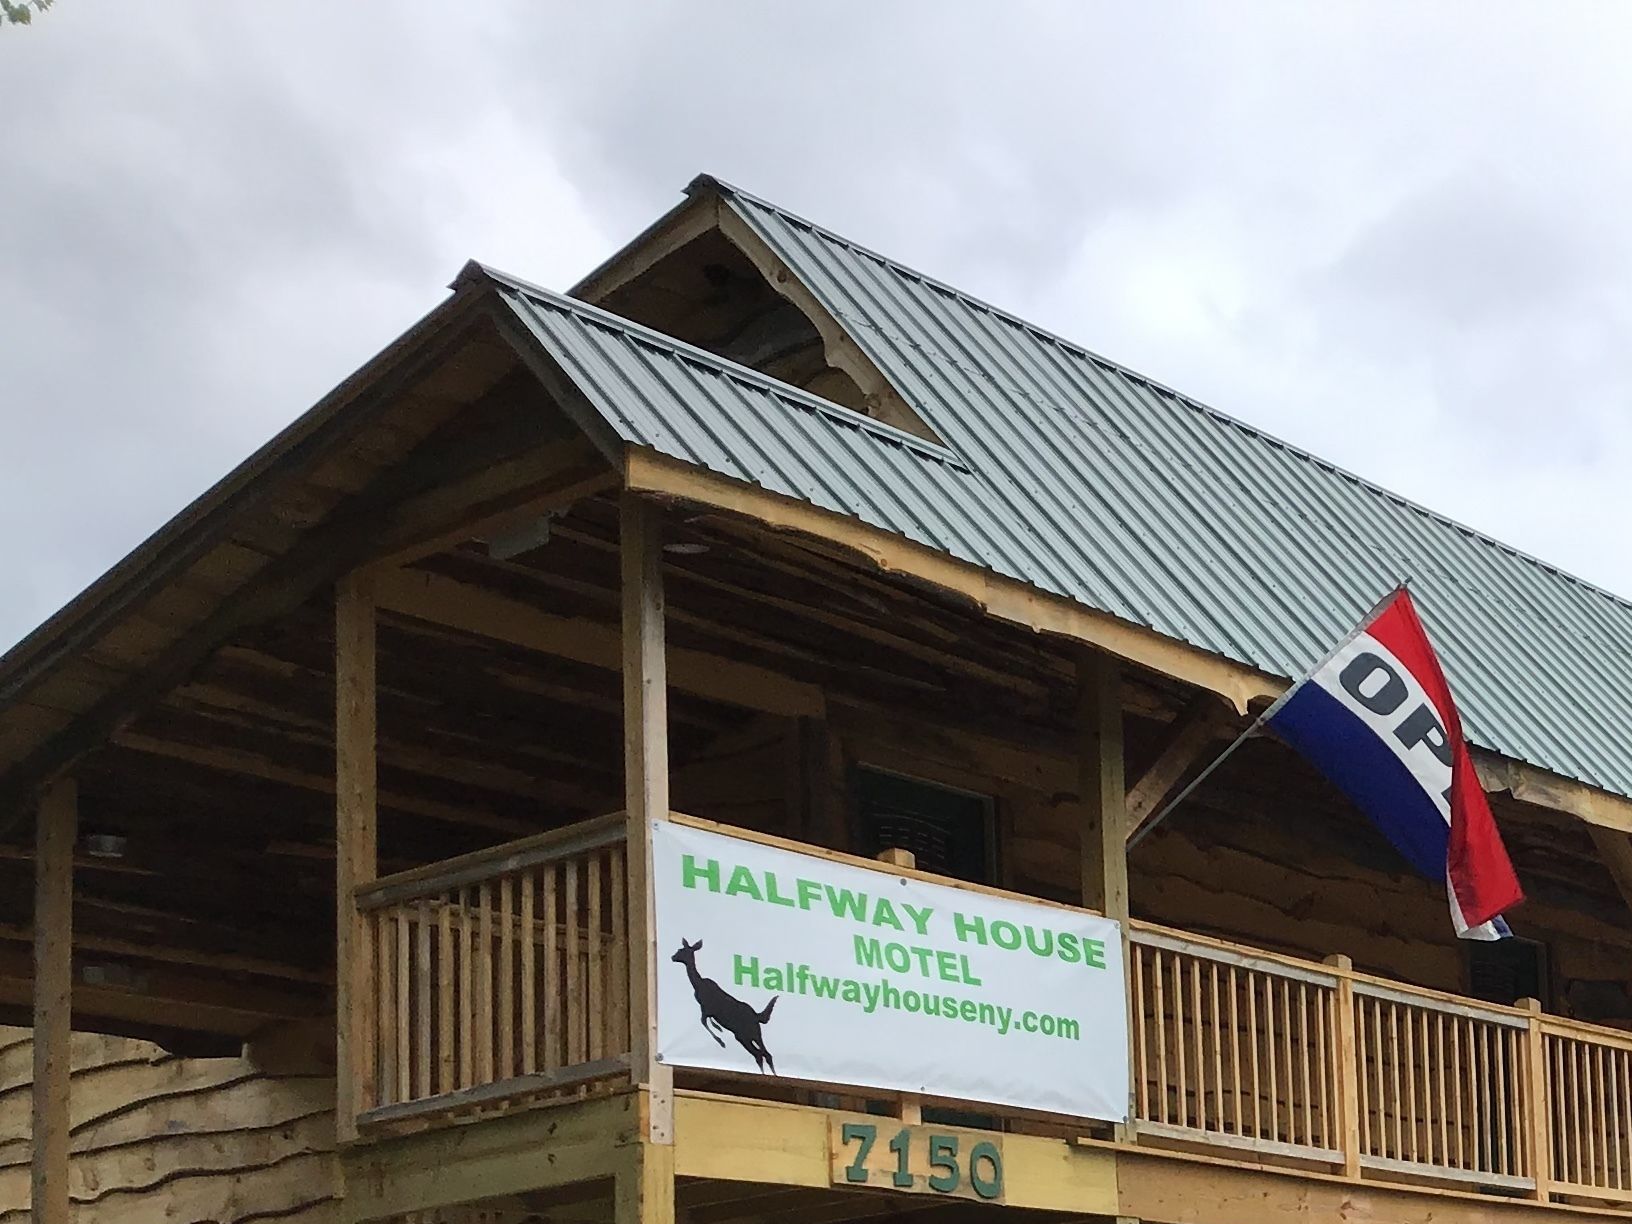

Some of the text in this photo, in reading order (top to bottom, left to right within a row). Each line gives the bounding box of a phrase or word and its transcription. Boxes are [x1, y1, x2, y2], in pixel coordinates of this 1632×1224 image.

[1339, 652, 1454, 808] OP
[681, 853, 1108, 971] HALFWAY HOUSE
[732, 953, 1081, 1041] Halfwayhouseny.com
[852, 934, 983, 987] MOTEL
[842, 1123, 1003, 1199] 7150
